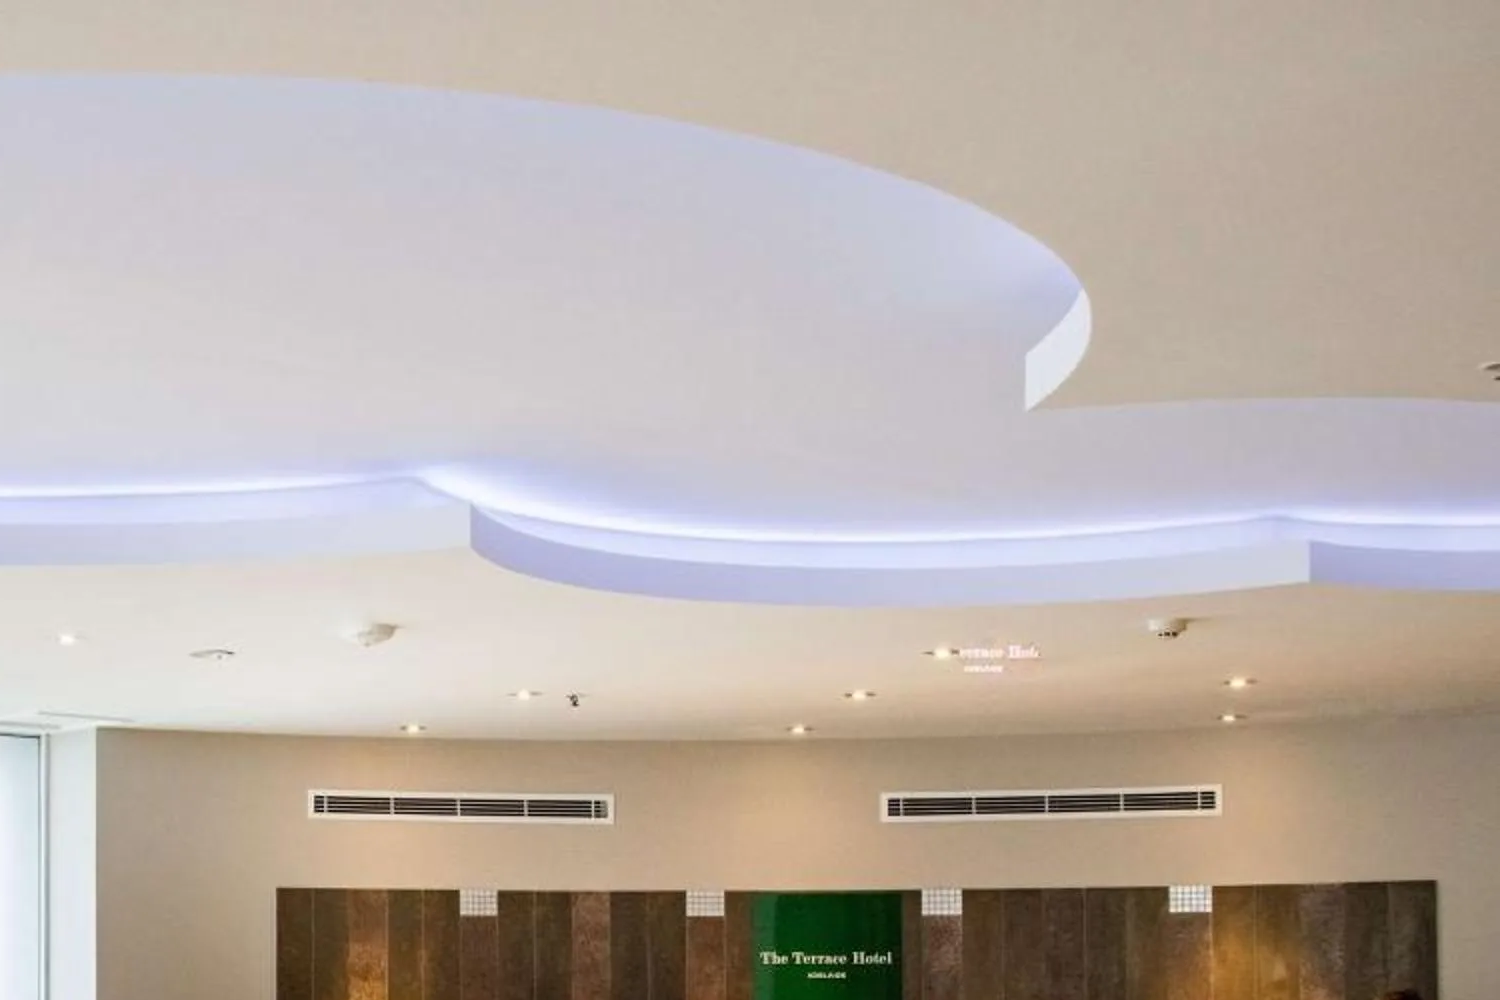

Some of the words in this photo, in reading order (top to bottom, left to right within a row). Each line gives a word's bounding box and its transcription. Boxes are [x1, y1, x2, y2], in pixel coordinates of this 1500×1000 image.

[759, 950, 789, 965] The
[791, 950, 848, 965] Terrace
[851, 950, 893, 965] Hotel
